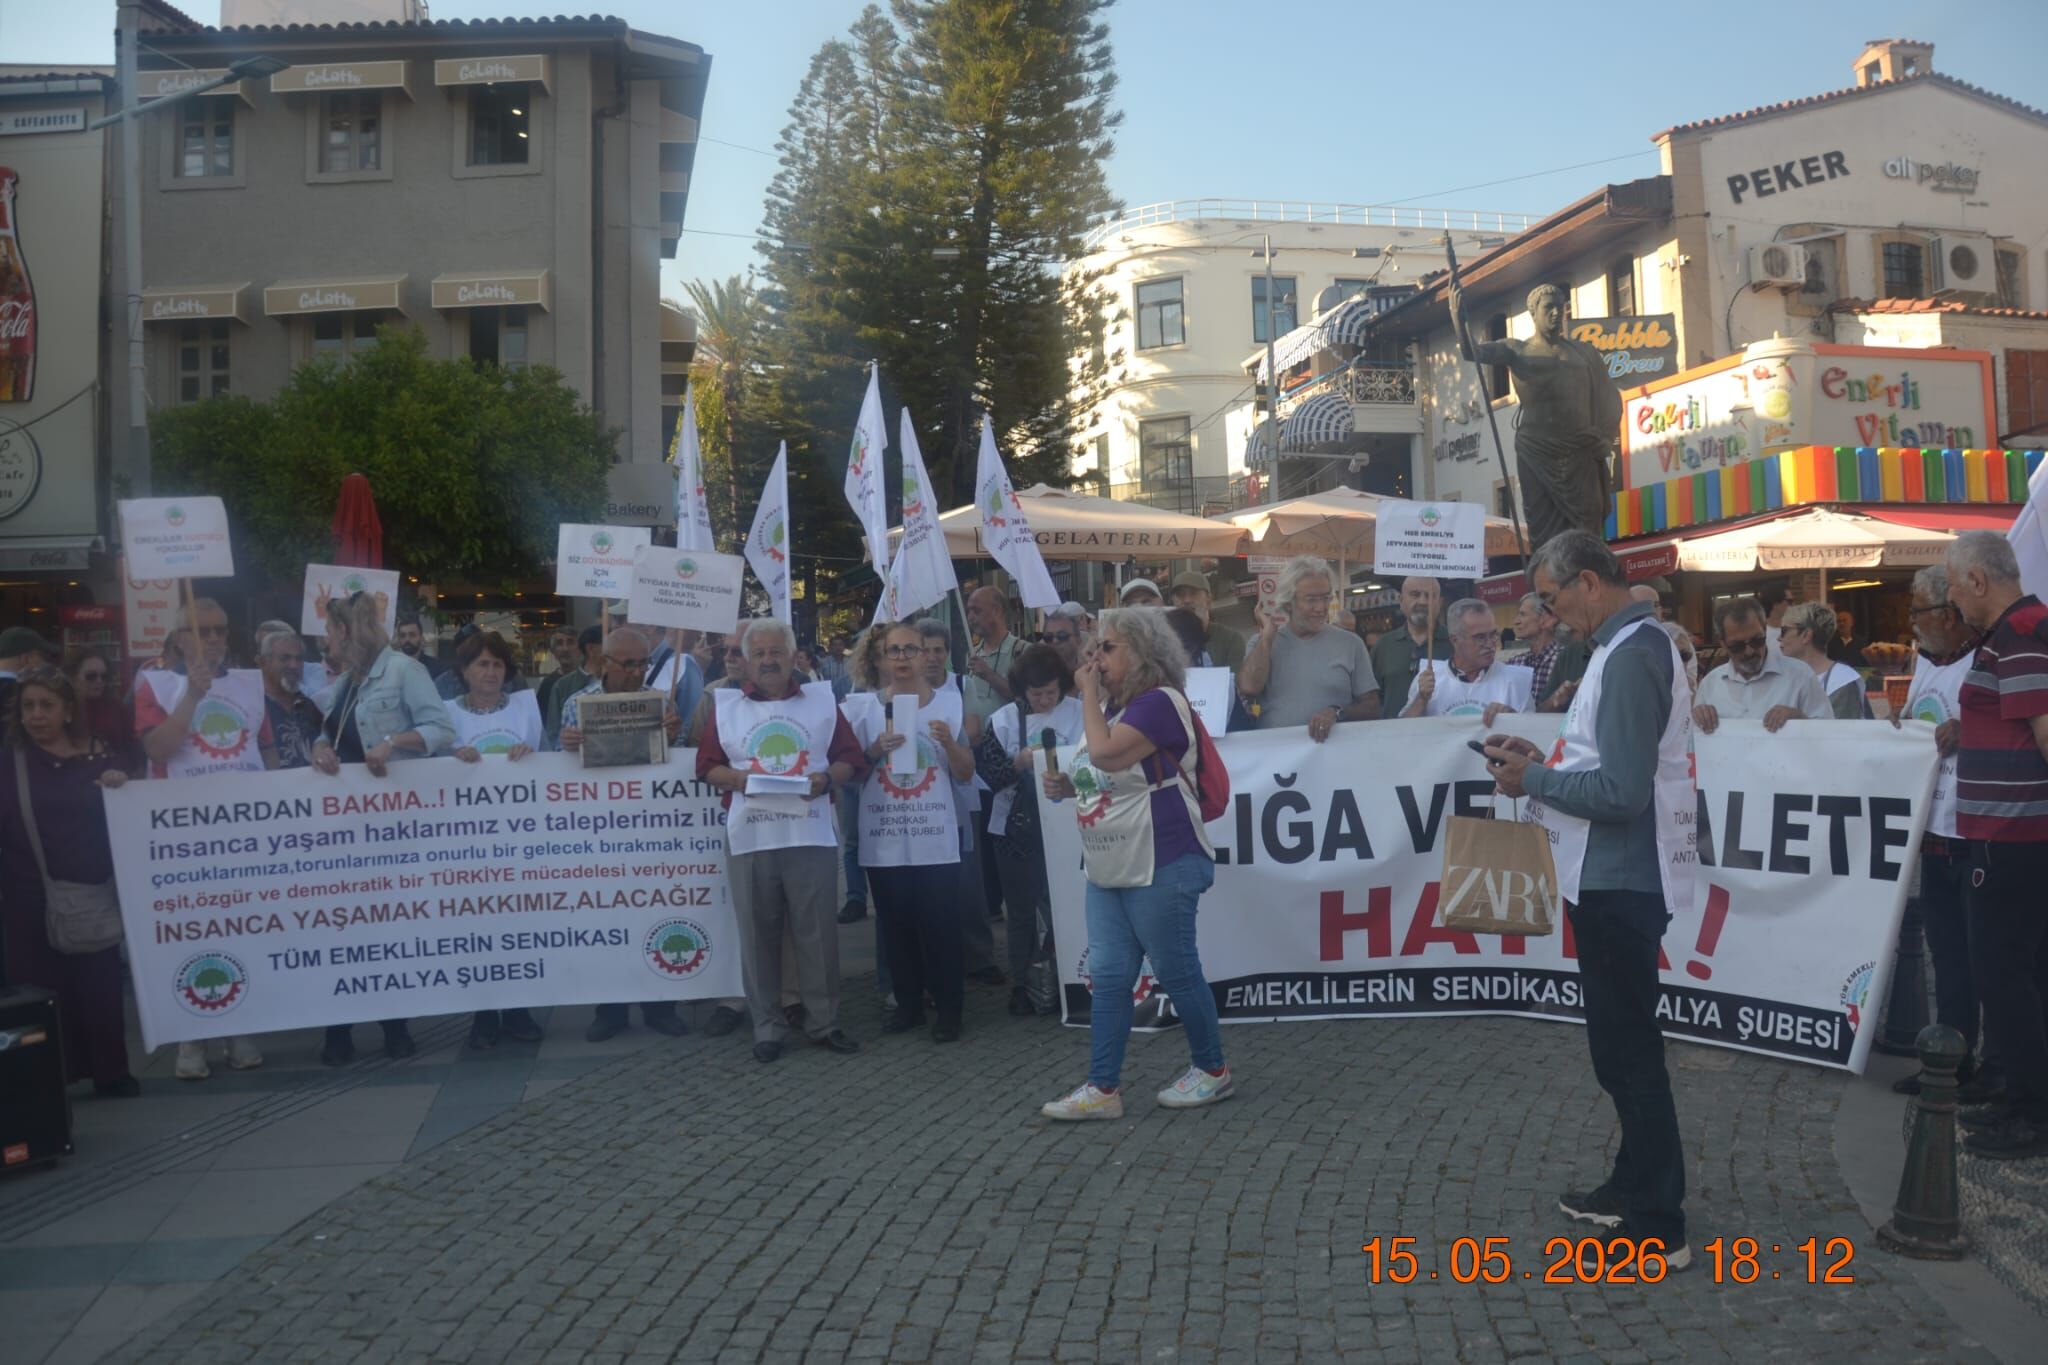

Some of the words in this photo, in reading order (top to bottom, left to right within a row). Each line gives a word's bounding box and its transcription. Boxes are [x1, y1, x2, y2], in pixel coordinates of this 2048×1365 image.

[1727, 150, 1851, 205] PEKER
[1571, 320, 1673, 351] Bubble
[1603, 351, 1665, 379] Brew
[607, 503, 662, 519] Bakery
[1034, 531, 1180, 547] GELATERIA
[1769, 549, 1787, 560] LA
[1791, 547, 1868, 560] GELATERIA
[150, 798, 312, 829] KENARDAN
[321, 789, 444, 816] BAKMA..!
[455, 780, 537, 806] HAYDİ
[545, 782, 598, 801] SEN
[607, 781, 642, 800] DE
[150, 837, 258, 861] insanca
[267, 829, 355, 856] yaşam
[364, 818, 498, 844] haklarımız
[507, 817, 536, 833] ve
[545, 809, 694, 834] taleplerimiz
[151, 850, 420, 889] çocuklarımıza,torunlarımıza
[425, 844, 486, 862] onurlu
[493, 843, 518, 858] bir
[524, 840, 594, 859] gelecek
[600, 837, 683, 853] bırakmak
[689, 836, 722, 852] için
[153, 888, 252, 913] eşit,özgür
[258, 887, 281, 902] ve
[287, 878, 393, 899] demokratik
[399, 875, 424, 889] bir
[430, 866, 515, 887] TÜRKİYE
[521, 862, 626, 881] mücadelesi
[632, 861, 722, 880] veriyoruz.
[155, 914, 285, 945] İNSANCA
[292, 899, 429, 932] YAŞAMAK
[439, 883, 712, 918] HAKKIMIZ,ALACAĞIZ
[1445, 865, 1554, 925] ZARA
[268, 948, 321, 971] TÜM
[329, 932, 492, 966] EMEKLİLERİN
[500, 927, 629, 951] SENDİKASI
[333, 968, 449, 996] ANTALYA
[456, 958, 544, 988] ŞUBESİ
[1225, 973, 1415, 1009] EMEKLİLERİN
[1432, 972, 1587, 1008] SENDİKASI
[1736, 1005, 1841, 1052] ŞUBESİ
